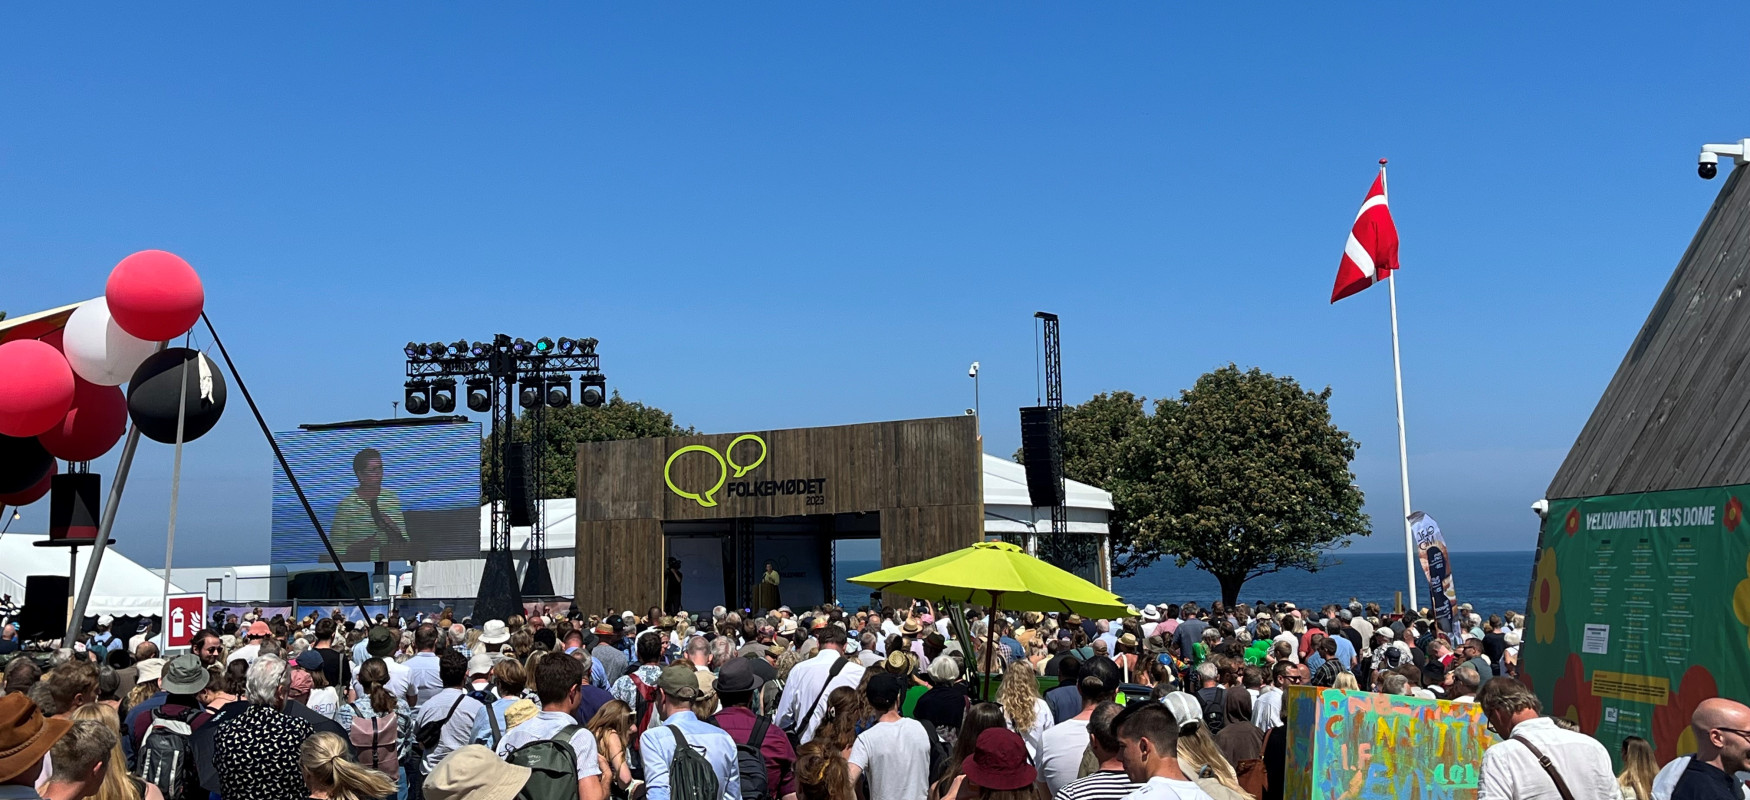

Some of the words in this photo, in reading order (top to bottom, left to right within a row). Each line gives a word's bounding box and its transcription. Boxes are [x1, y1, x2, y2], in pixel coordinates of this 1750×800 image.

[727, 478, 826, 497] FOLKEMØDET
[806, 496, 824, 505] 2023
[1586, 509, 1643, 530] VELKOMMEN
[1644, 508, 1659, 528] TIL
[1660, 507, 1682, 527] BL'S
[1682, 506, 1716, 526] DOME
